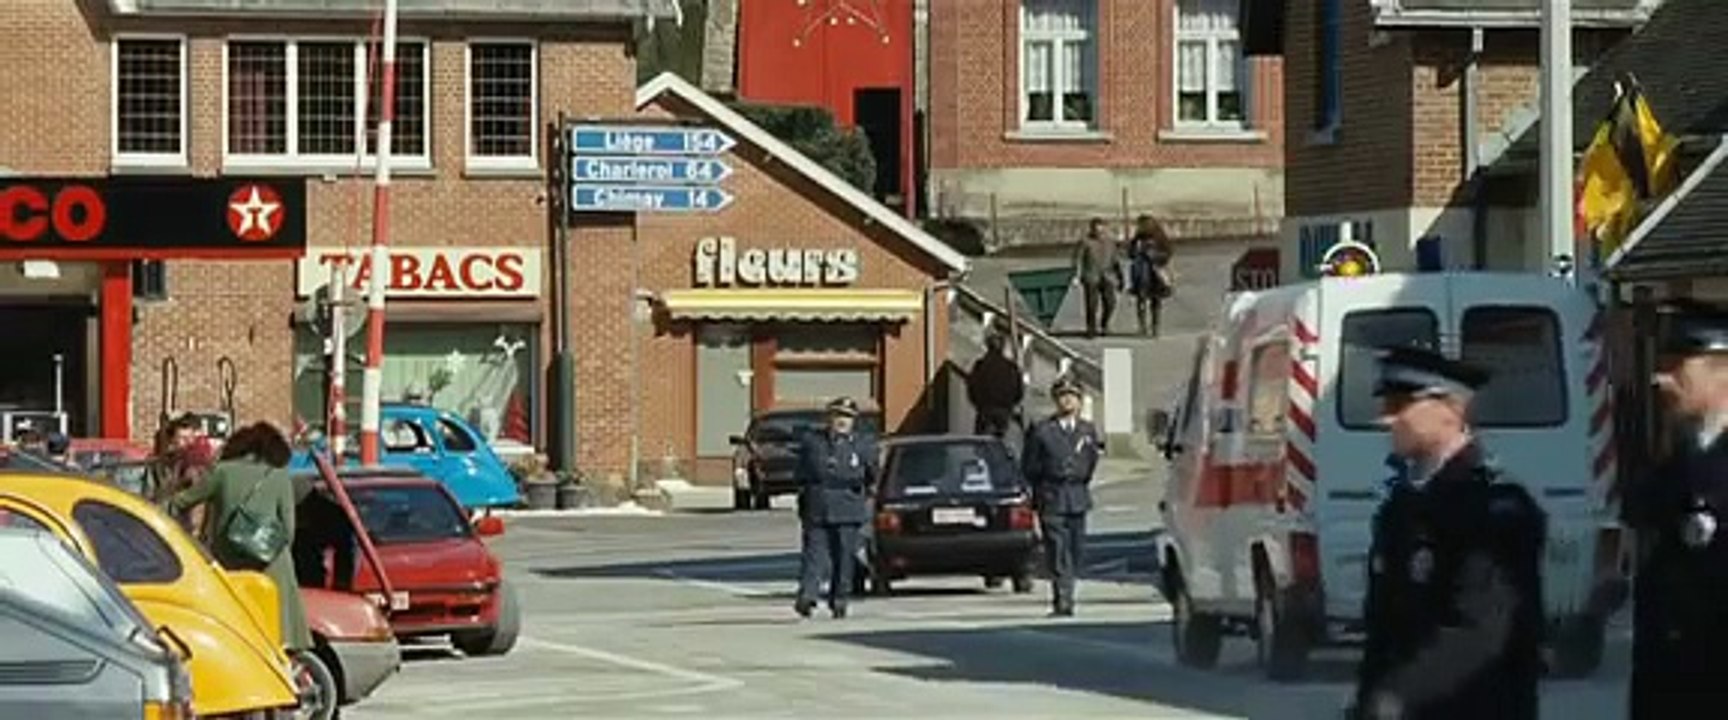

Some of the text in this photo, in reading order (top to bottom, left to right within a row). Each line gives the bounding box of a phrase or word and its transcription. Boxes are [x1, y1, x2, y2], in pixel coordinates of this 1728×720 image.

[586, 159, 673, 178] Charleroi
[594, 188, 707, 208] Chimay 14
[694, 236, 858, 286] fleurs
